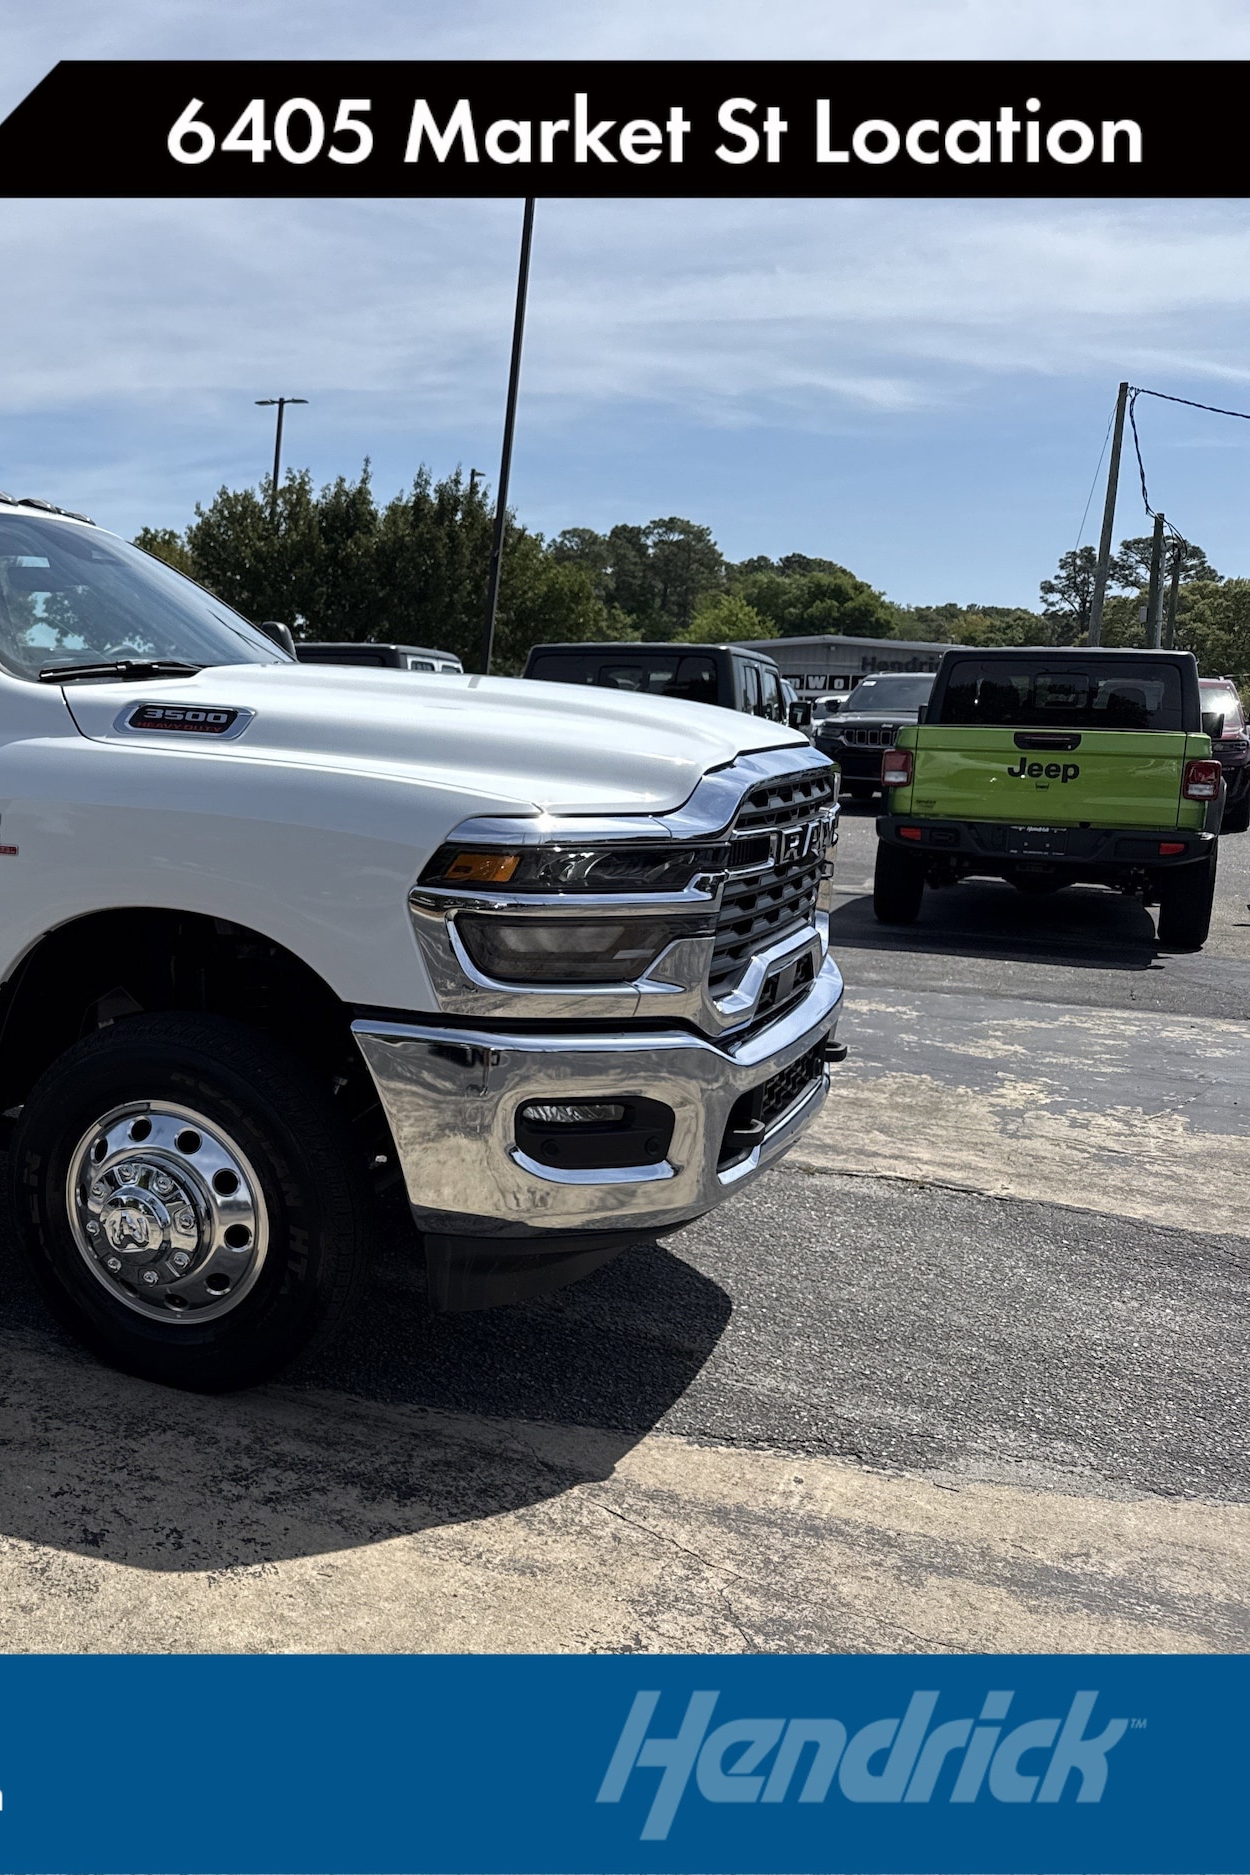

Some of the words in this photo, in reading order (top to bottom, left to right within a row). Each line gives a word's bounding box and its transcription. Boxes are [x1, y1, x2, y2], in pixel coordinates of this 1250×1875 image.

[861, 655, 941, 673] Hendri
[143, 708, 228, 724] 3500
[1007, 757, 1080, 783] Jeep
